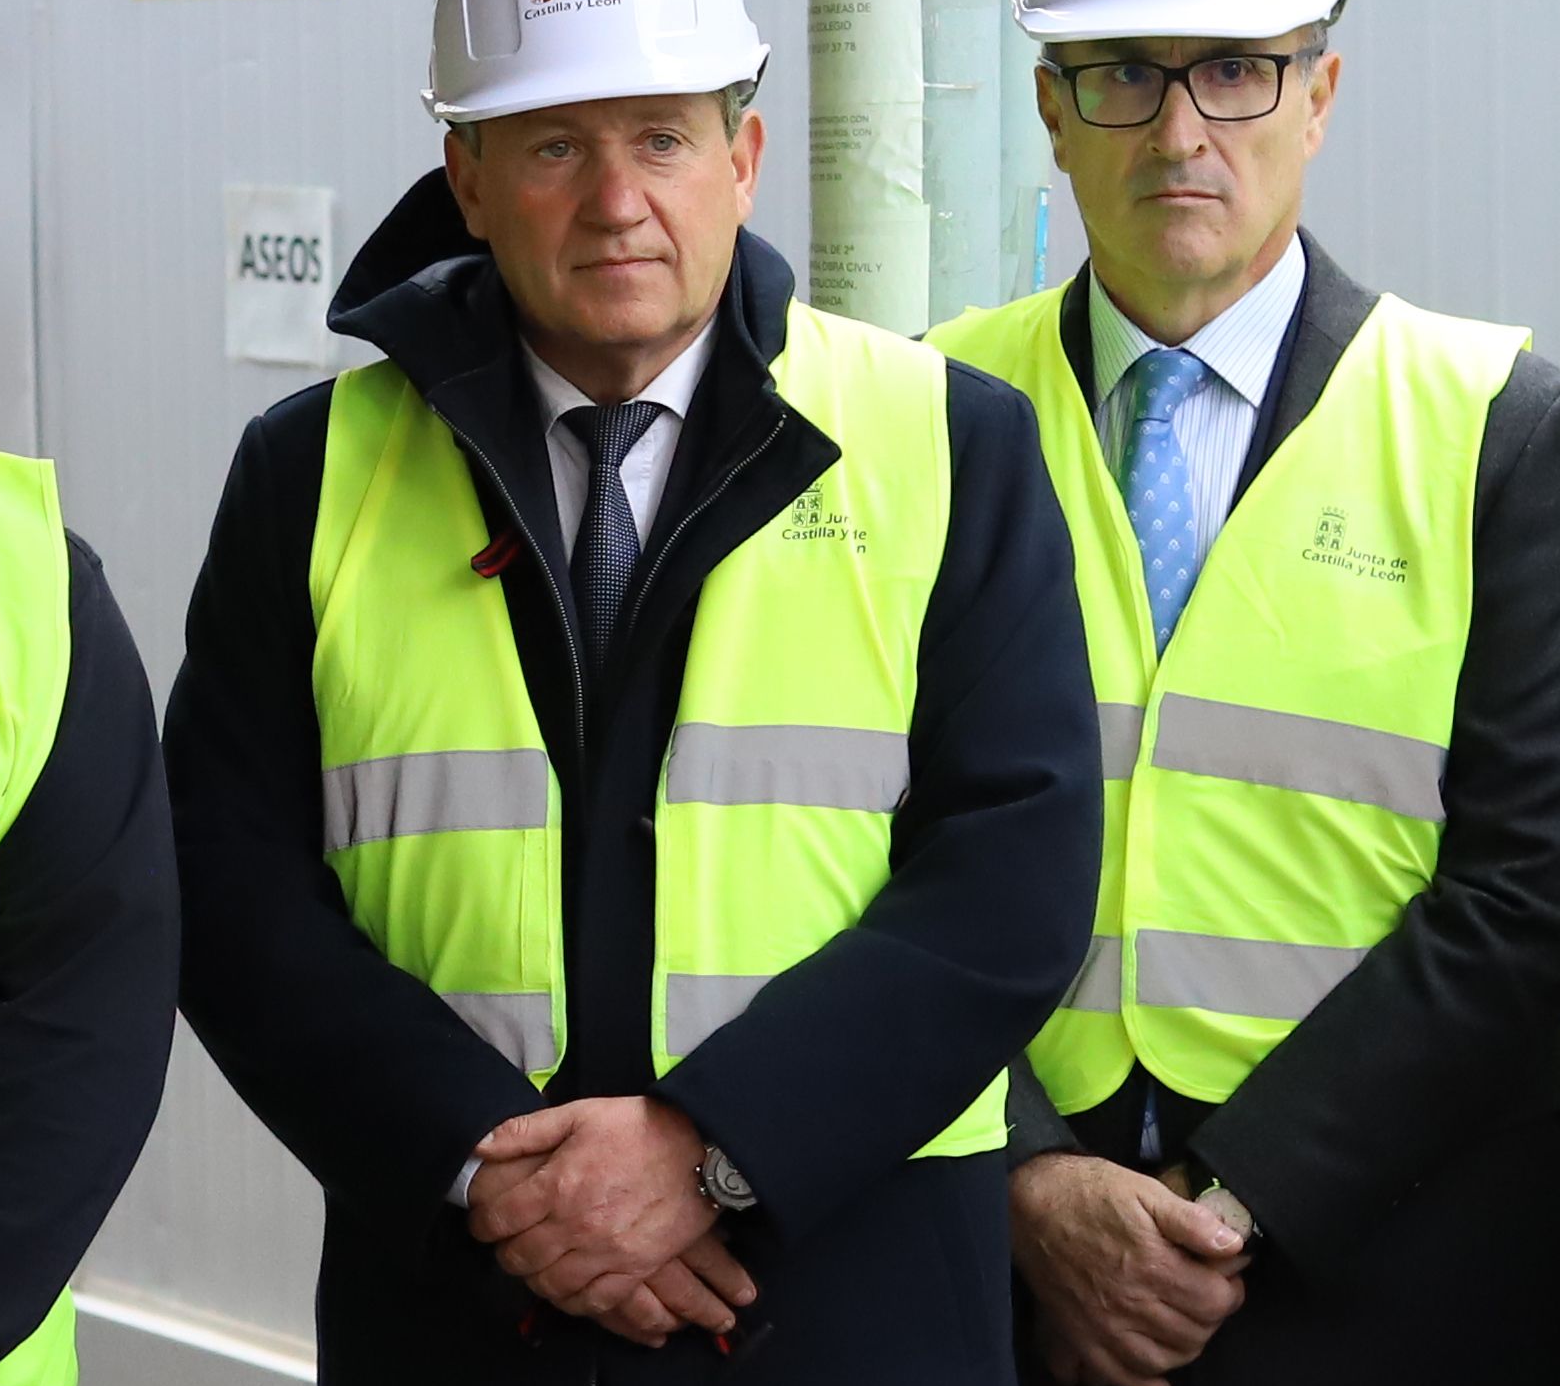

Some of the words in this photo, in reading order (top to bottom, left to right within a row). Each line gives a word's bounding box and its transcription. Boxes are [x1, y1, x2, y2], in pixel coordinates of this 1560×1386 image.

[524, 0, 571, 20] Castilla
[575, 0, 583, 11] y
[857, 2, 872, 13] DE
[830, 244, 841, 255] DE
[239, 234, 322, 283] ASEOS
[846, 262, 873, 273] CIVIL
[875, 263, 882, 273] Y
[782, 527, 835, 540] Castilla
[839, 529, 849, 541] y
[1302, 548, 1353, 570] Castilla
[1356, 565, 1366, 576] y
[1370, 567, 1406, 583] León
[1346, 546, 1386, 565] Junta
[1390, 557, 1408, 569] de
